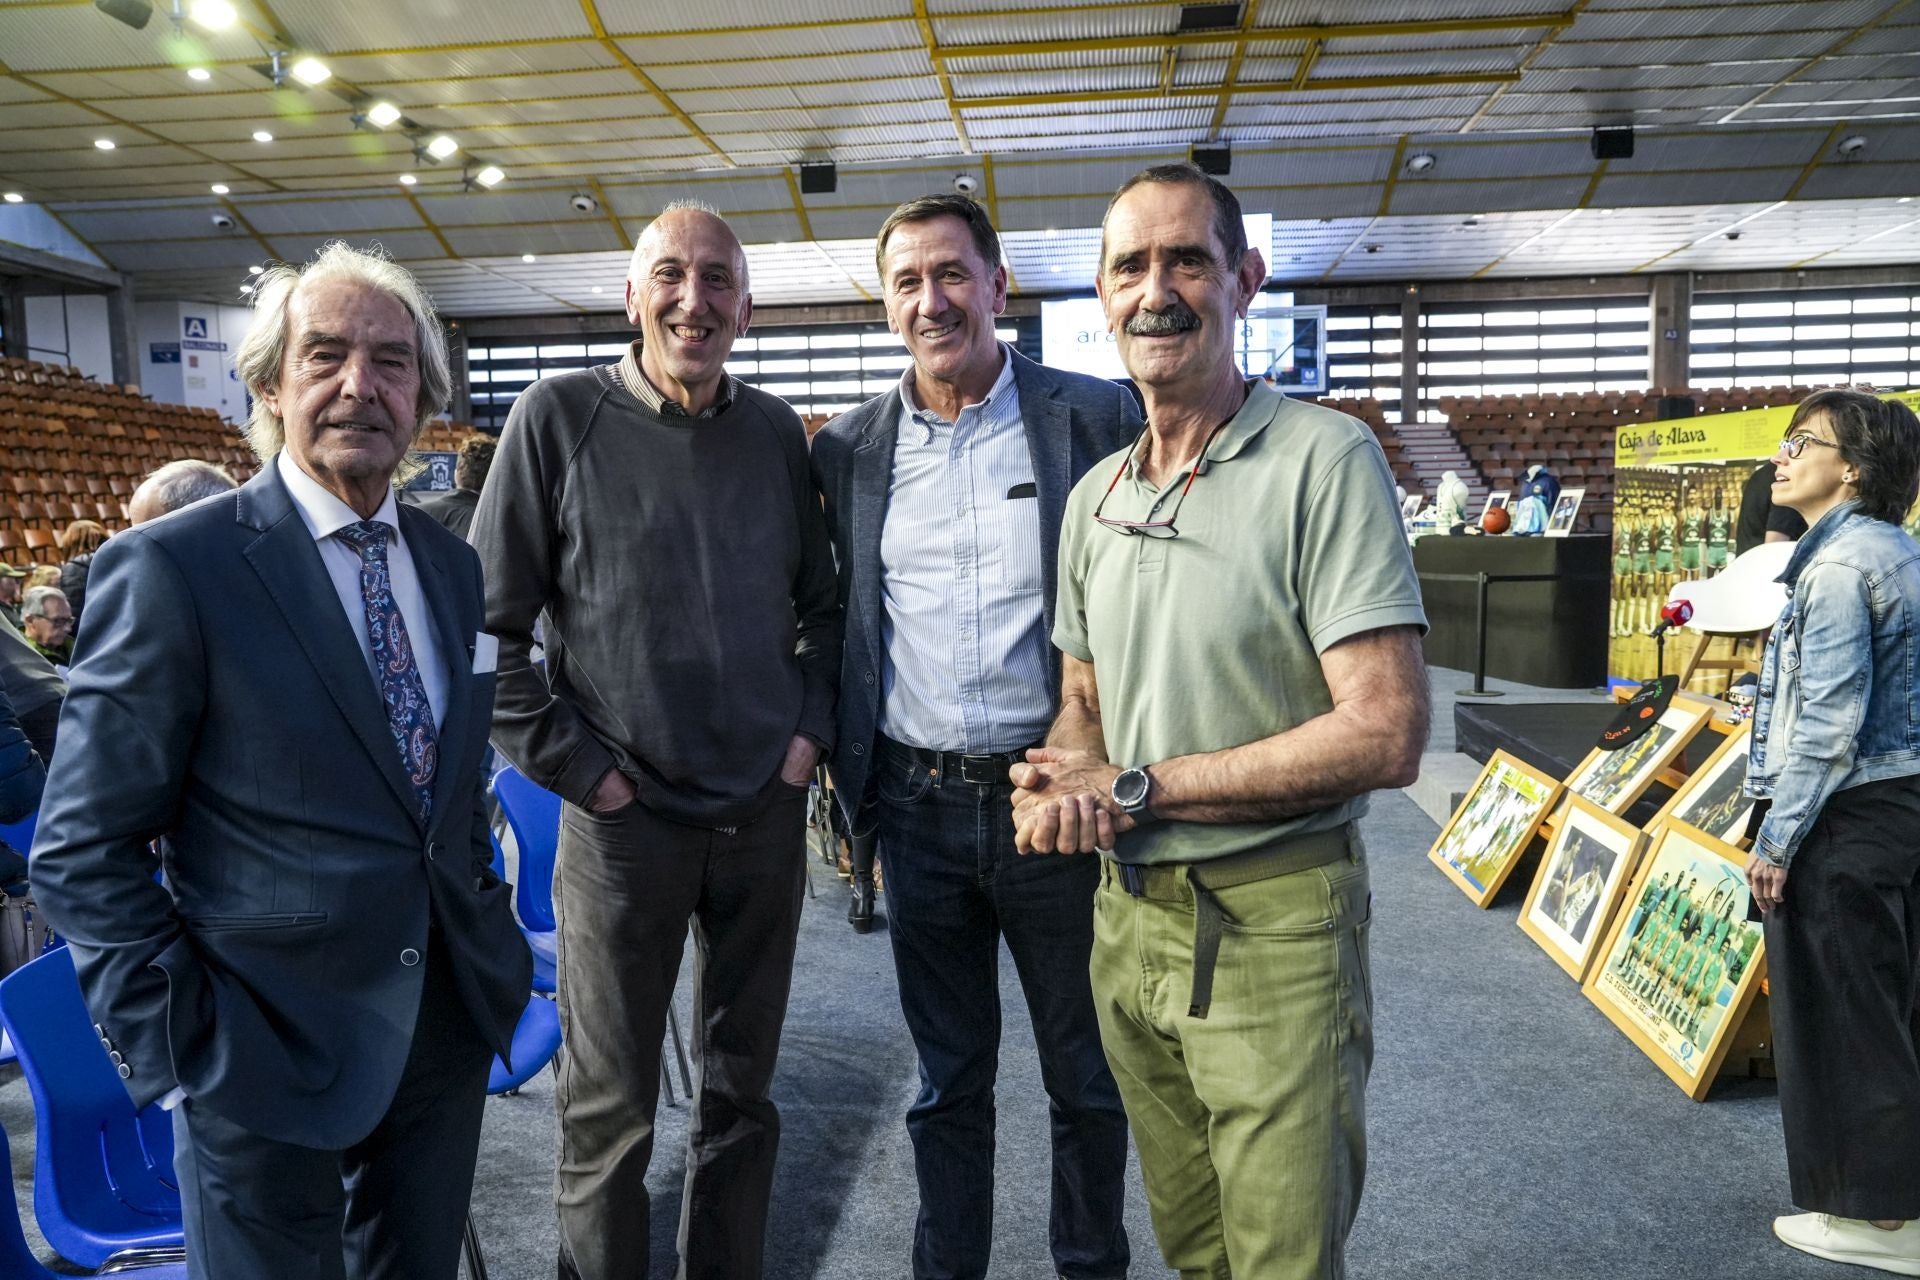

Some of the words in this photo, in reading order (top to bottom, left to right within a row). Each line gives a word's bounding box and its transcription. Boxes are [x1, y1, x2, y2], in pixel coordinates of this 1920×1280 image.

[187, 319, 205, 336] A
[1619, 432, 1644, 452] Caja
[1647, 429, 1663, 447] de
[1666, 427, 1706, 445] Alava
